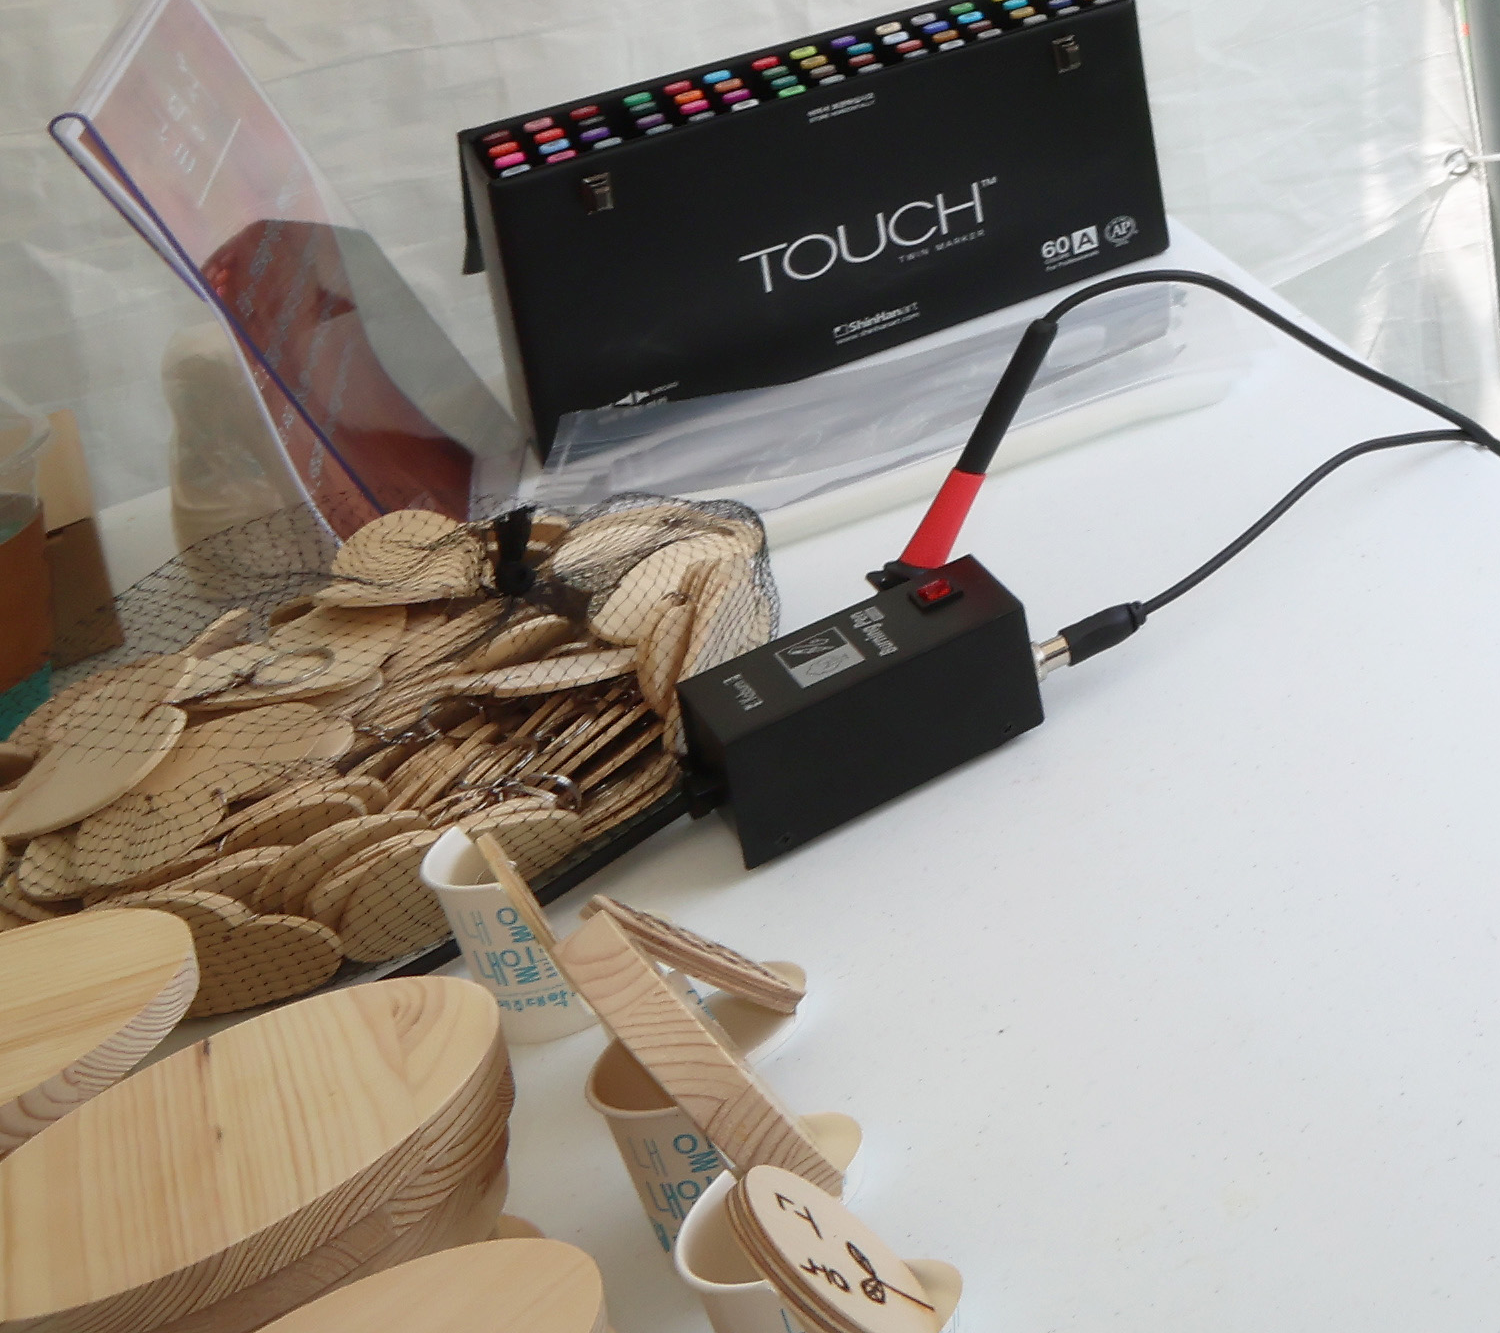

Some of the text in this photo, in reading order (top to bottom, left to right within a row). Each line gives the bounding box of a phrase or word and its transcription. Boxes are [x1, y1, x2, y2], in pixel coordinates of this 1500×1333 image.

[738, 181, 985, 293] TOUCH
[935, 228, 986, 251] MARKER
[1041, 236, 1071, 259] 60
[862, 622, 899, 657] Burning
